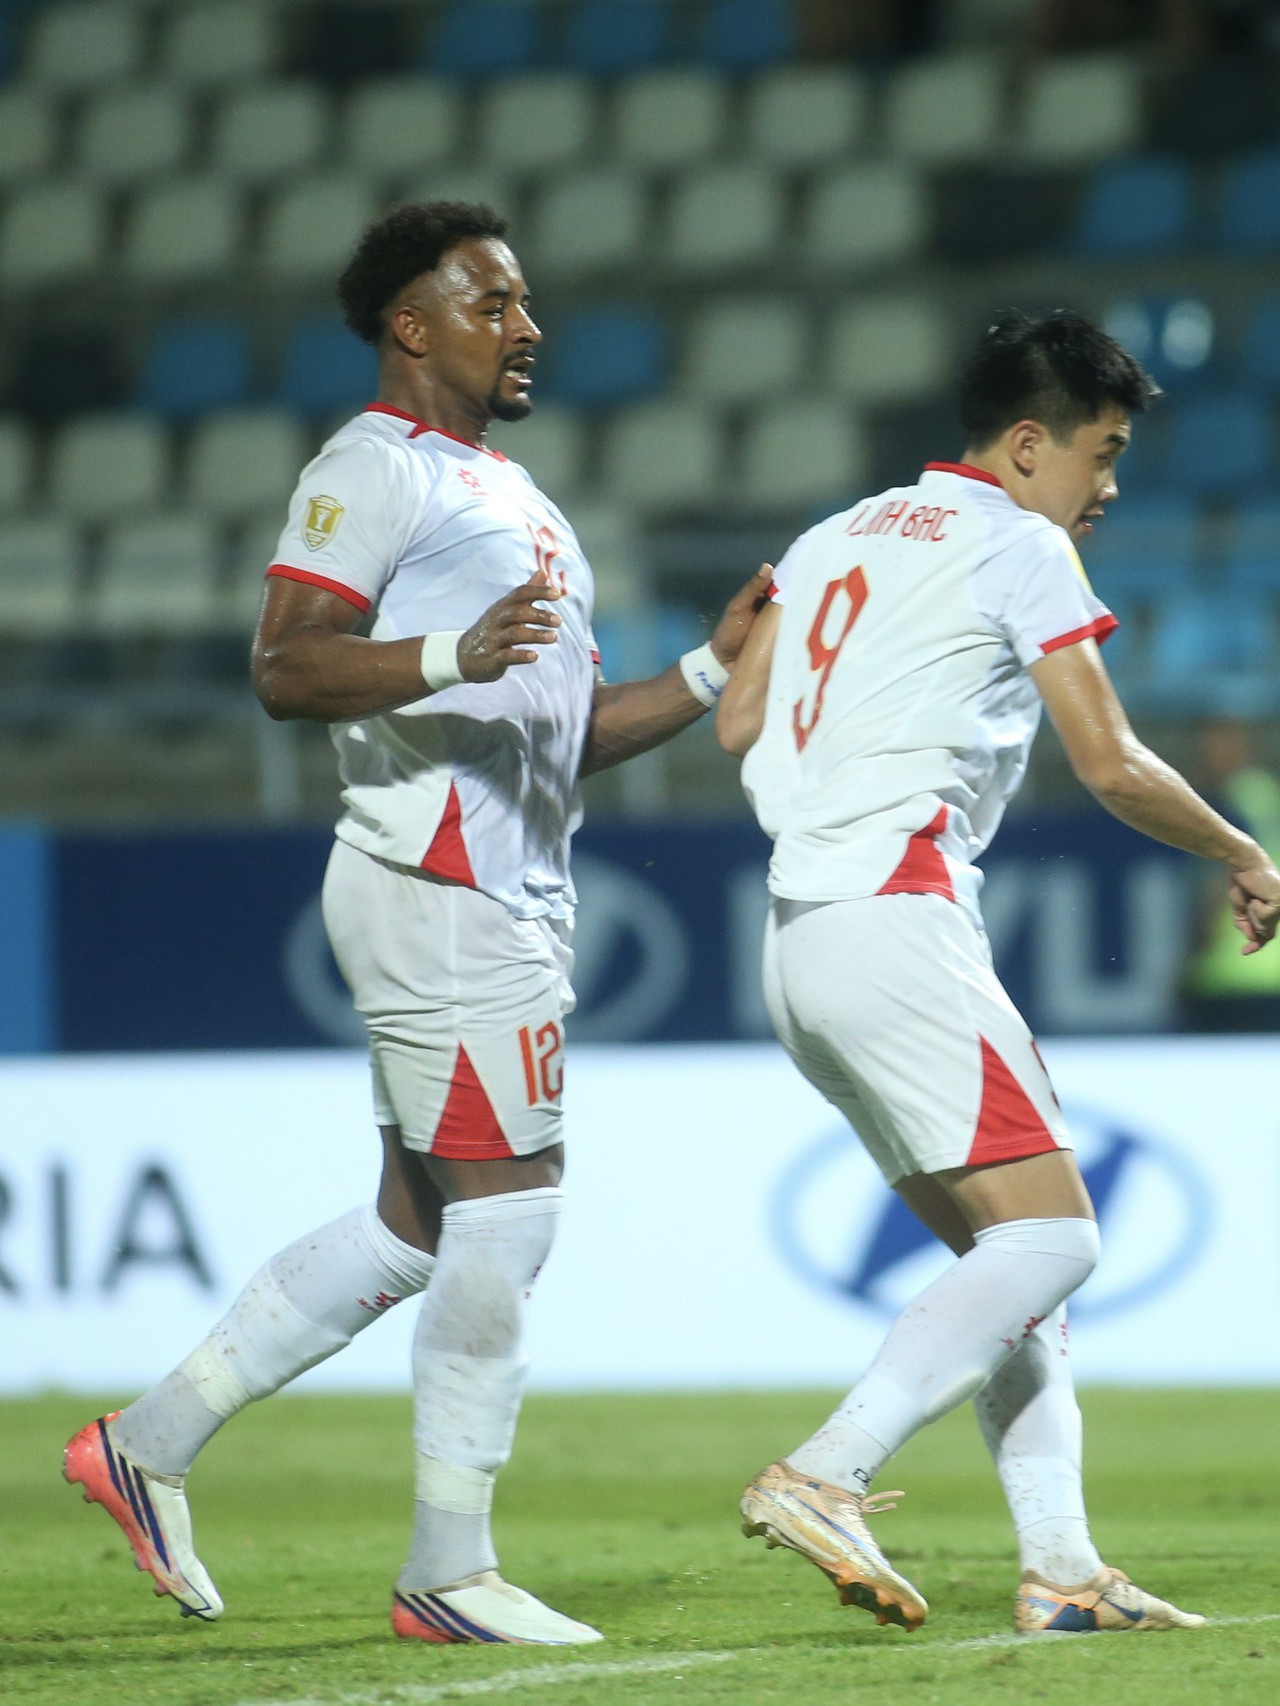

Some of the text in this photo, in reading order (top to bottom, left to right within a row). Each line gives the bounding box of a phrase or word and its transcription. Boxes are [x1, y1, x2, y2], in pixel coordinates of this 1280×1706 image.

[526, 522, 568, 596] 12
[793, 563, 869, 754] 9
[518, 1020, 563, 1106] 12
[0, 1163, 215, 1293] IA
